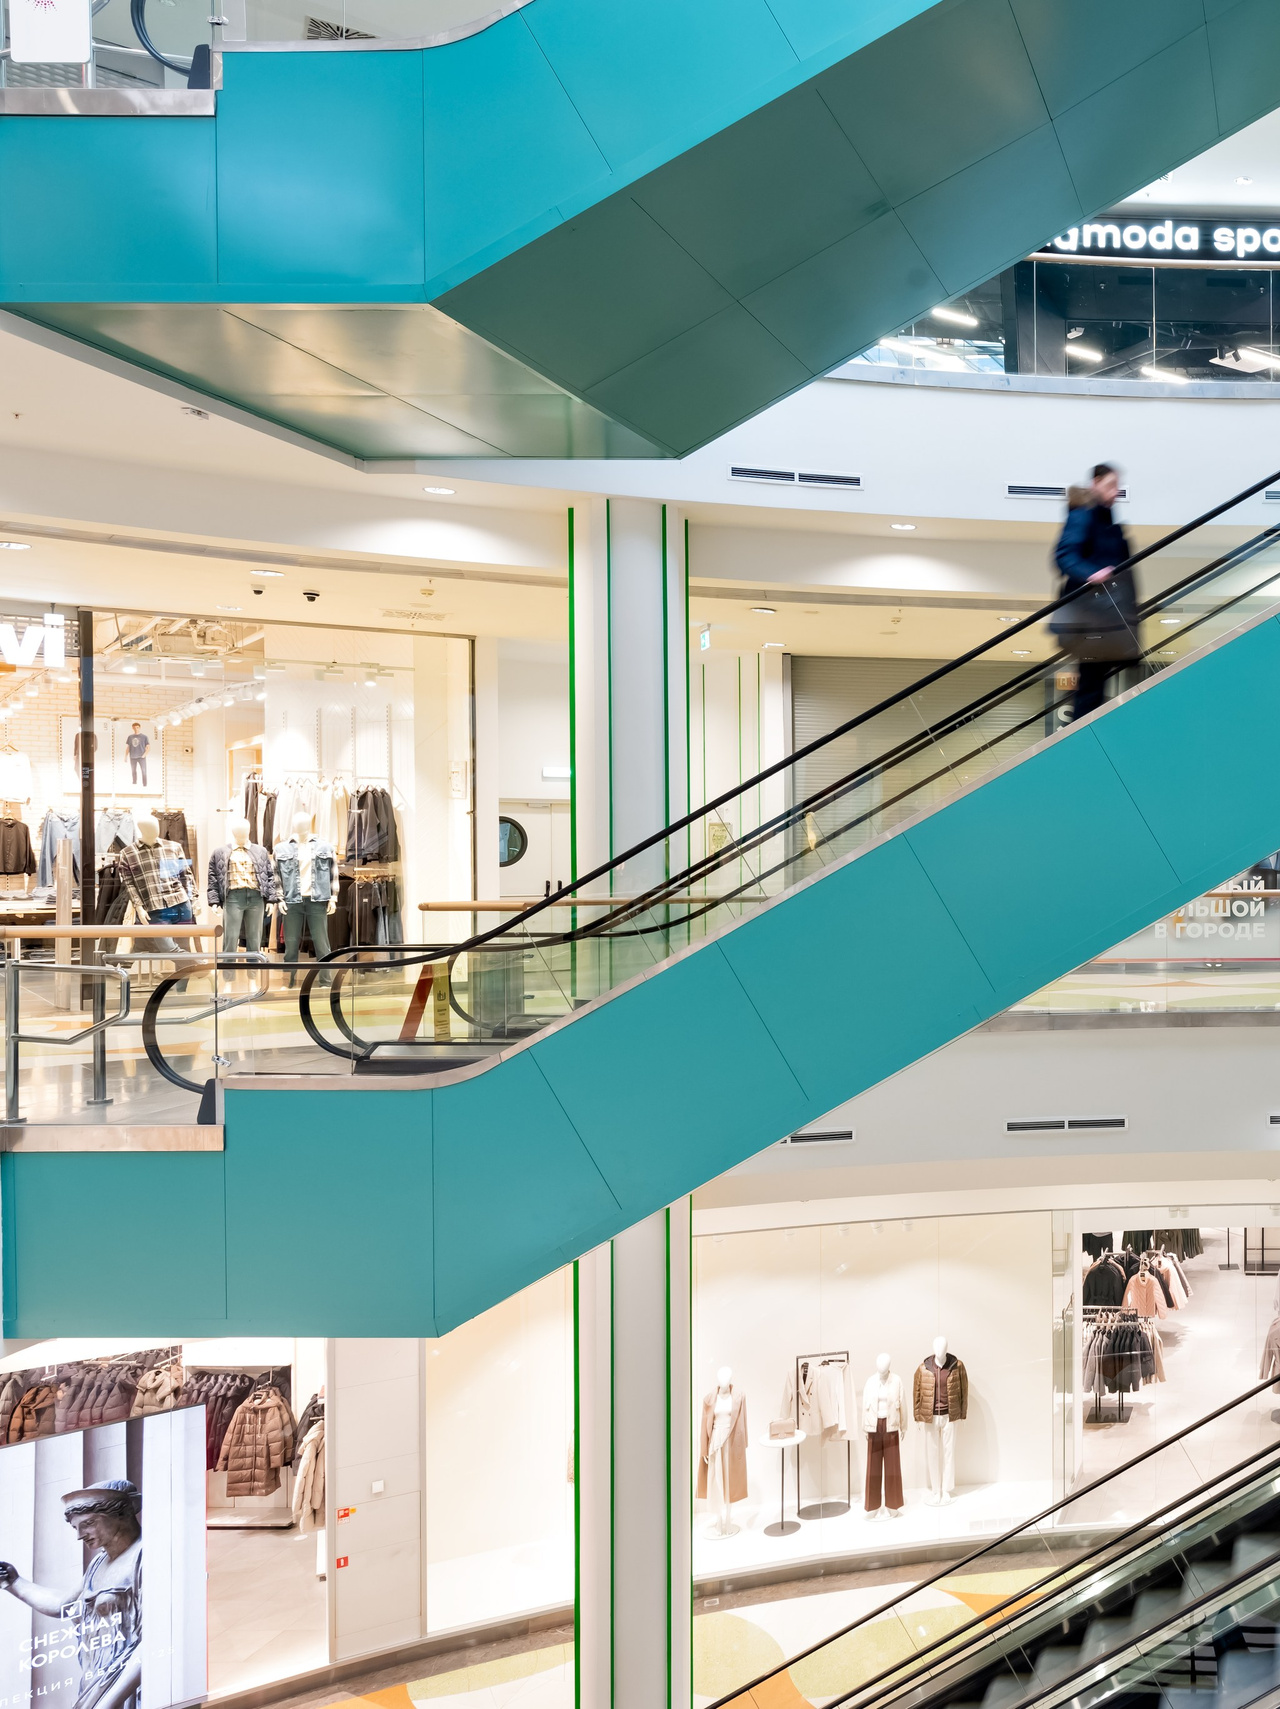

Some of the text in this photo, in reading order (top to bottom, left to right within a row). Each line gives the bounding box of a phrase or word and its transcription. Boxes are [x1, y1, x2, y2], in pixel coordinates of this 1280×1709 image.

[1047, 220, 1199, 251] amoda
[1170, 897, 1265, 917] ЛЬШОЙ
[1155, 923, 1266, 940] В ГОРОДЕ
[18, 1612, 122, 1653] СНЕЖНАЯ
[18, 1630, 126, 1673] КОРОЛЕВА
[84, 1656, 142, 1681] ВЕСНА
